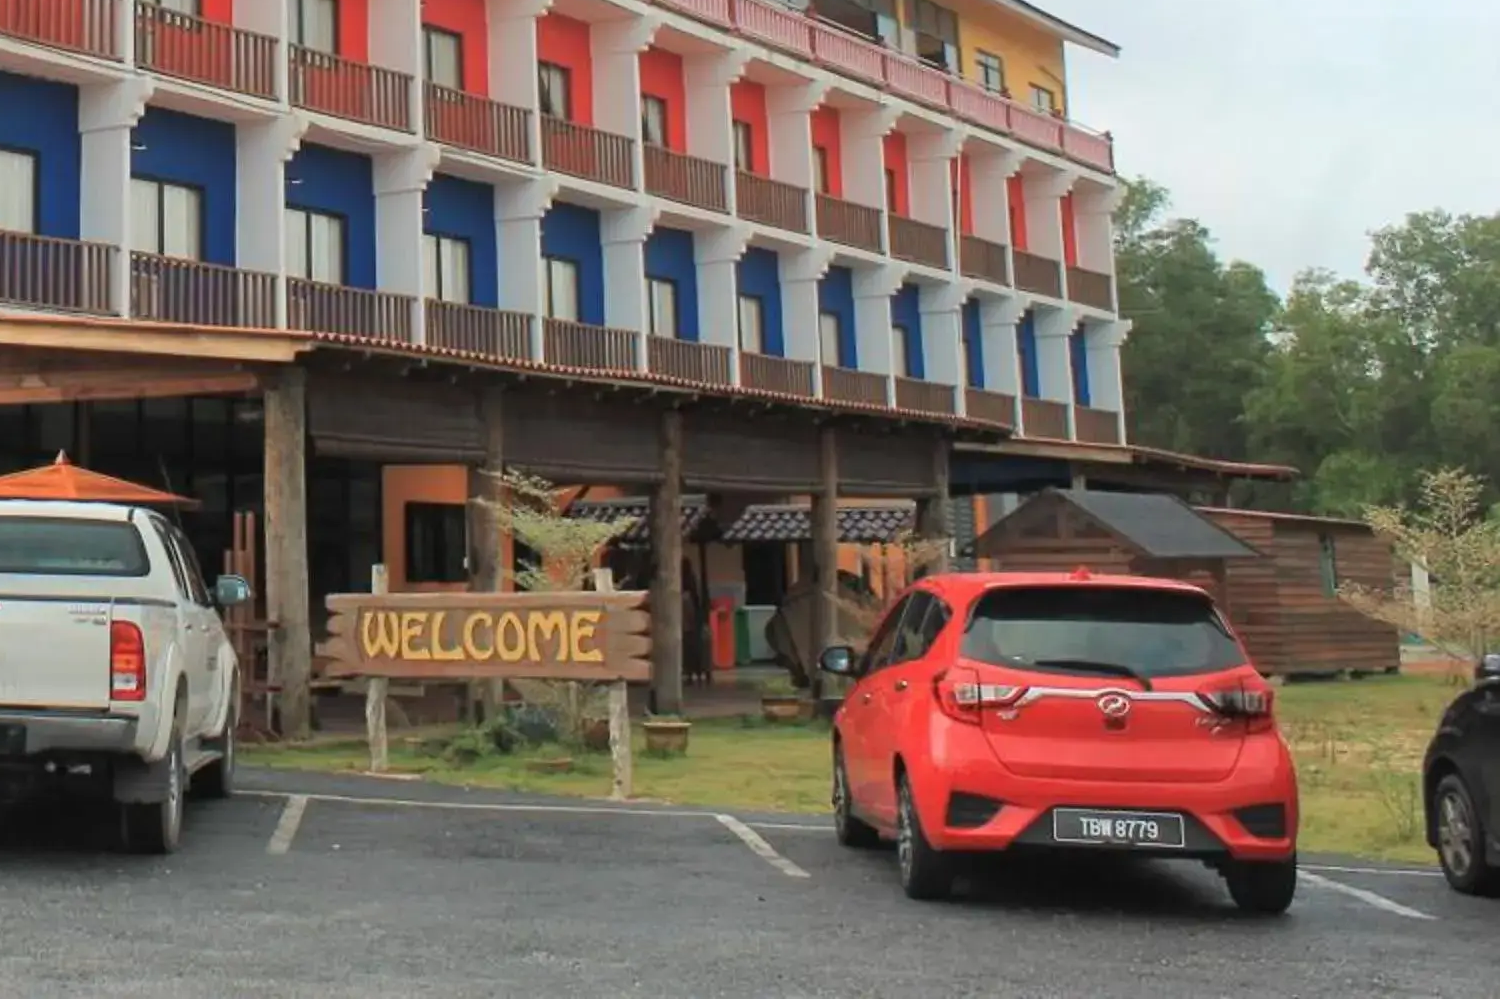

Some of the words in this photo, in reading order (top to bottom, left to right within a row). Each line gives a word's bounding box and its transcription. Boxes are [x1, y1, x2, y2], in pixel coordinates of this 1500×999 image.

[362, 609, 604, 662] WELCOME
[1079, 817, 1112, 837] TBW
[1115, 818, 1159, 839] 8779
